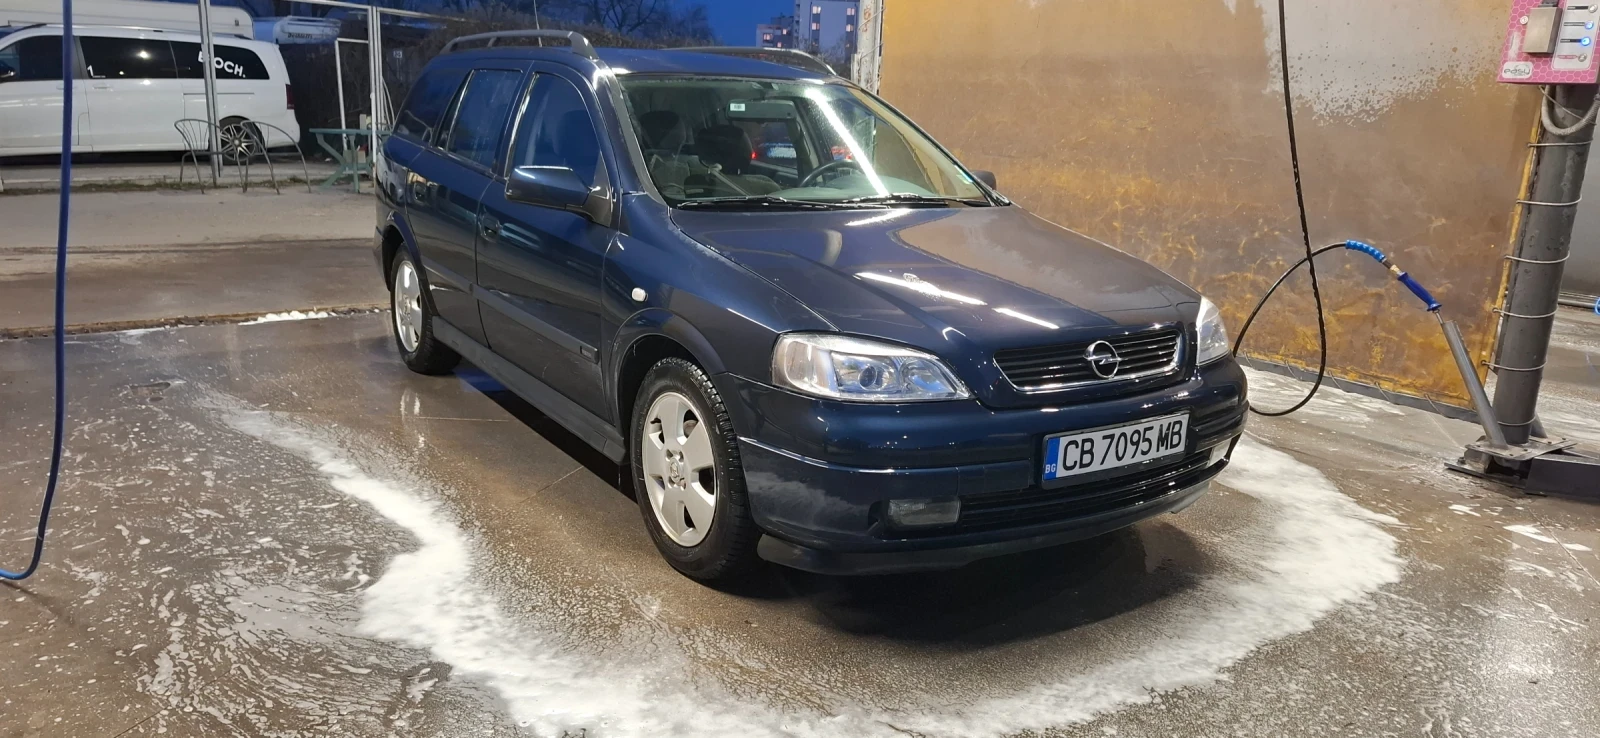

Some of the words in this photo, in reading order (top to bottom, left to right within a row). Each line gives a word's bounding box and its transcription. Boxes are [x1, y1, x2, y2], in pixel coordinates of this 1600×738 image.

[198, 51, 246, 78] OCH.
[1062, 438, 1095, 471] CB
[1100, 426, 1155, 465] 7095
[1156, 420, 1183, 452] MB
[1045, 463, 1056, 474] BG
